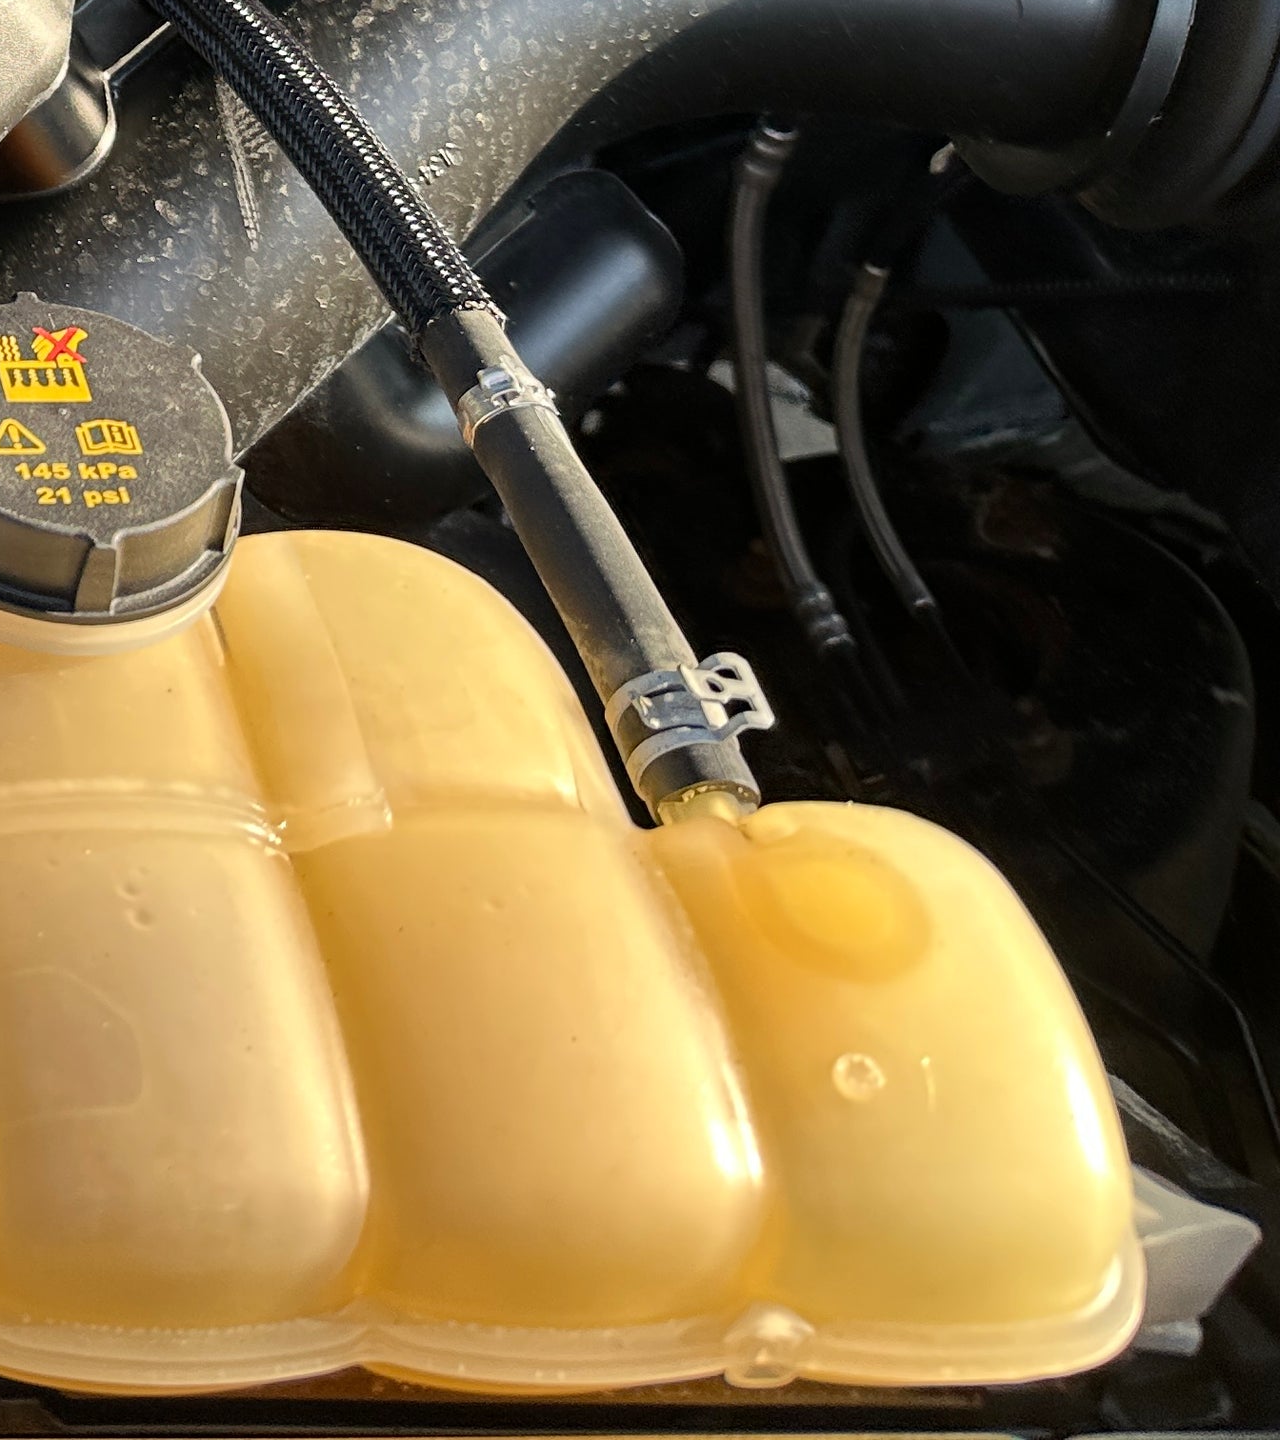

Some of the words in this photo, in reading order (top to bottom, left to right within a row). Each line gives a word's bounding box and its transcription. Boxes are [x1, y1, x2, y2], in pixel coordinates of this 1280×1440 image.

[15, 462, 71, 480] 145
[78, 461, 138, 480] kPa
[36, 487, 72, 506] 21
[83, 486, 130, 508] psi
